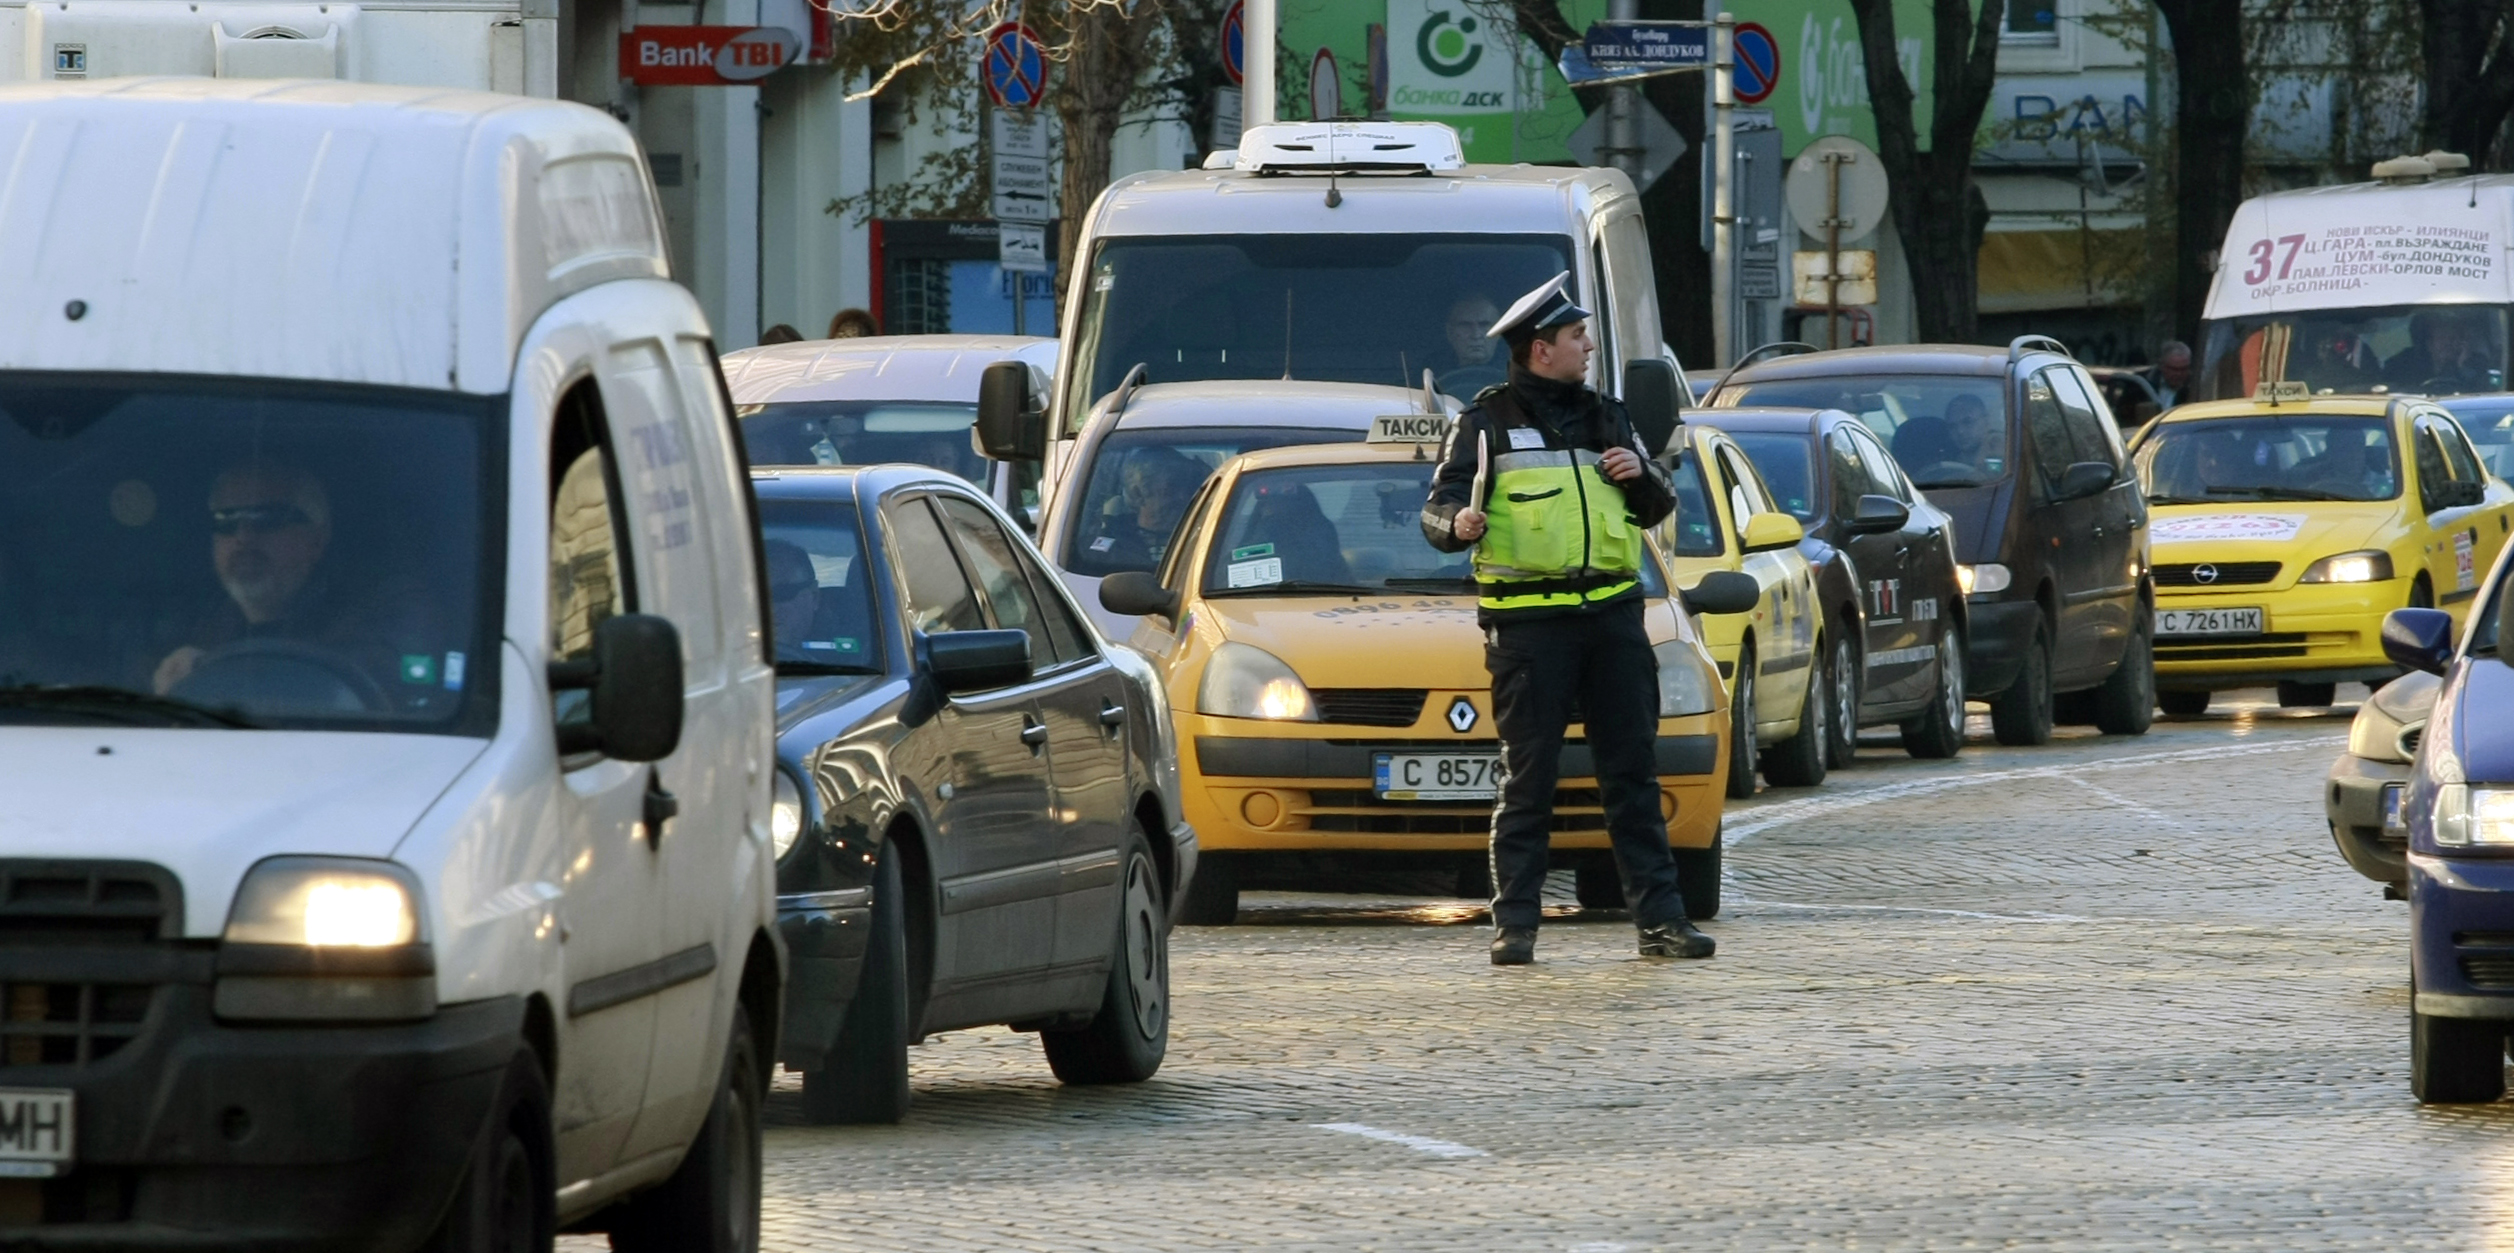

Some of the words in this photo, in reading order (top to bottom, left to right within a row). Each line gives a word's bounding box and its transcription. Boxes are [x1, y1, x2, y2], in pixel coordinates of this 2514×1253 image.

[640, 40, 714, 66] Bank
[730, 42, 783, 67] TBI
[1642, 45, 1705, 58] ДОНДУКОВ
[1394, 85, 1460, 106] банка
[1461, 92, 1504, 107] ДСК
[2326, 226, 2361, 239] НОВИ
[2363, 225, 2404, 236] ИСКЪР
[2415, 225, 2490, 241] ИЛИЯНЦИ
[2243, 232, 2306, 286] 37
[2333, 249, 2375, 264] ЦУМ
[2447, 265, 2489, 280] МОСТ
[1379, 418, 1443, 436] ТАКСИ
[2164, 613, 2177, 631] C
[1404, 759, 1422, 786] C
